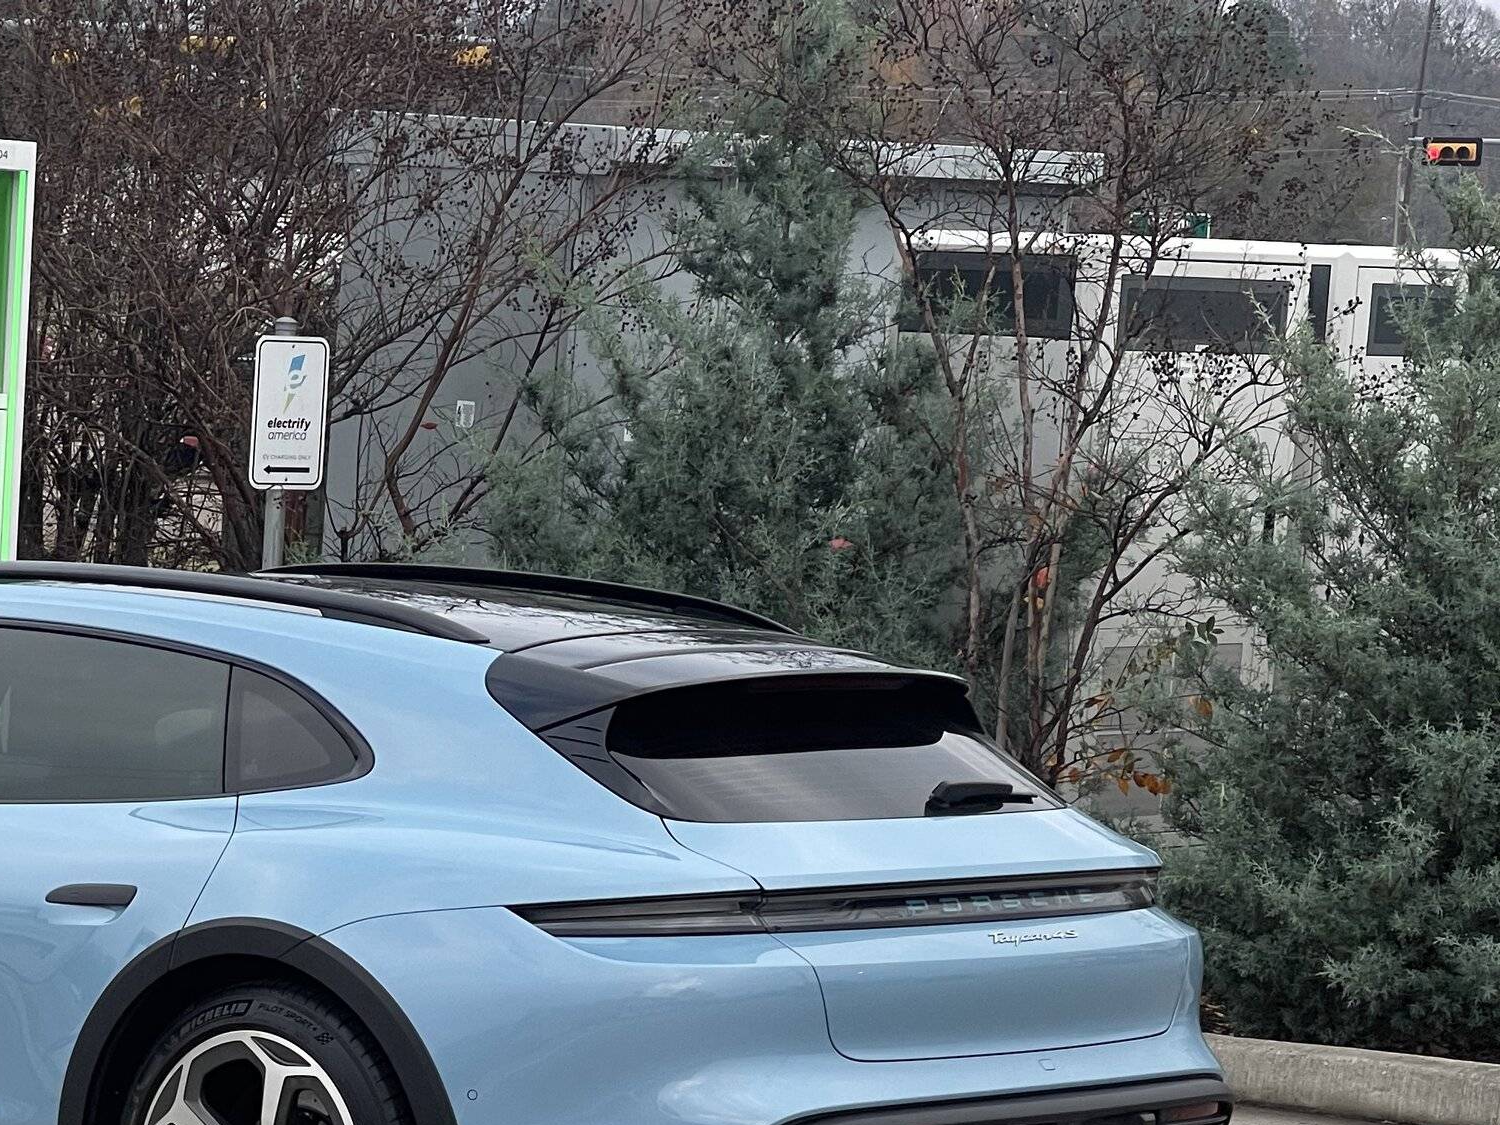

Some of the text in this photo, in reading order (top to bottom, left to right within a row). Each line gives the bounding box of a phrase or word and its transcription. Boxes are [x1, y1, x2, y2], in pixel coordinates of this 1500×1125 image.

[267, 417, 312, 432] electrify
[267, 431, 307, 441] america
[905, 889, 1095, 916] PORSCHE
[179, 1001, 249, 1038] MICHELIN
